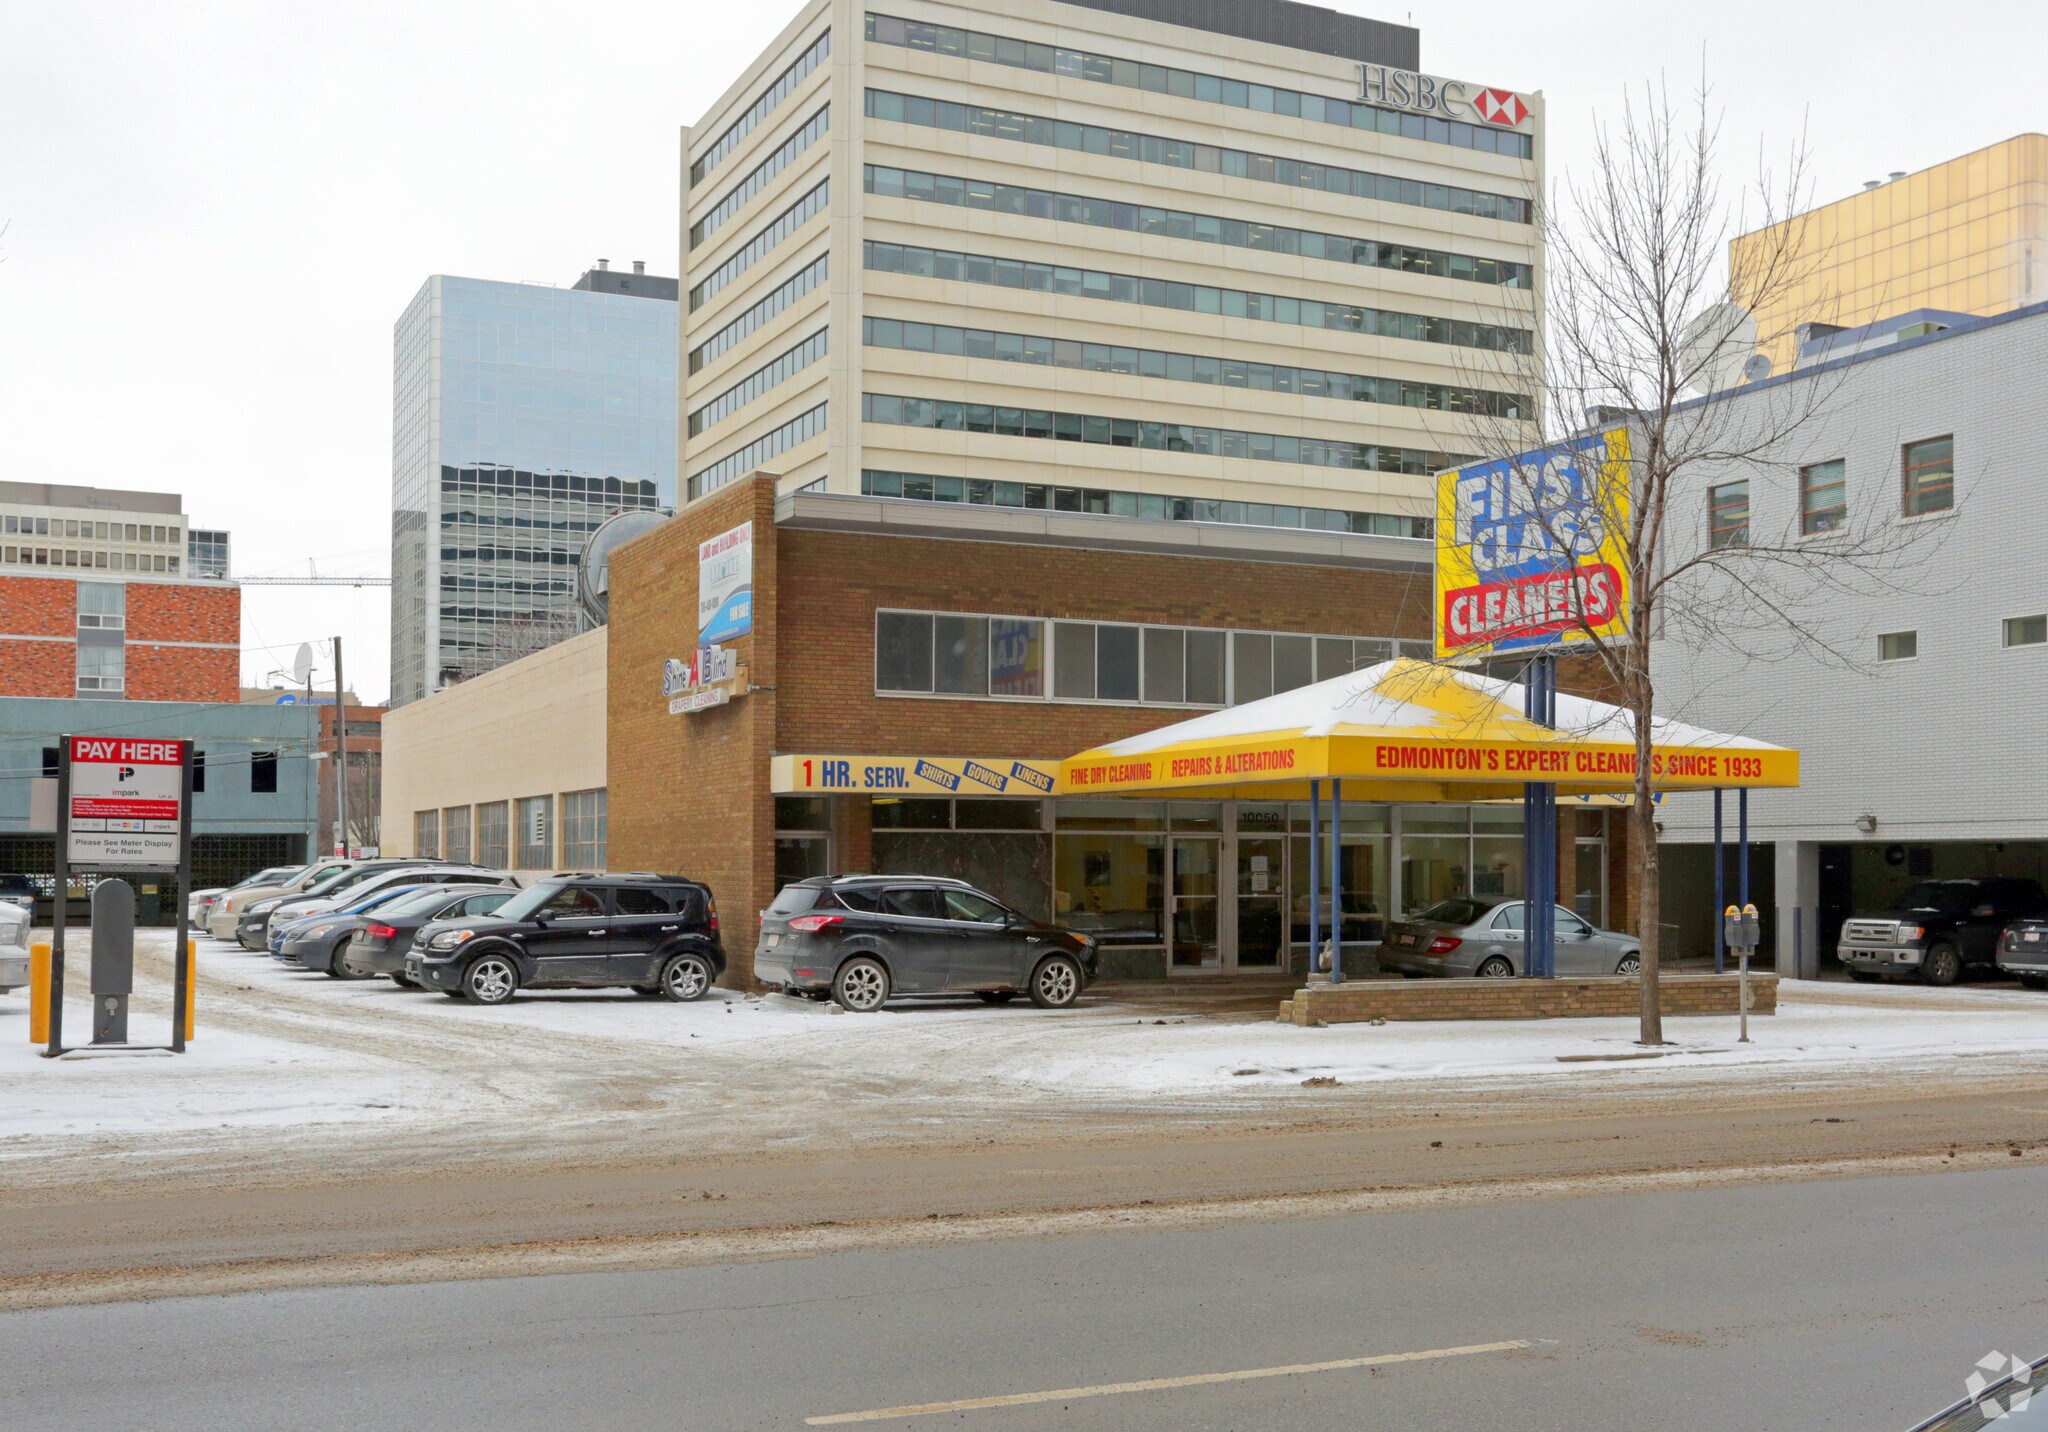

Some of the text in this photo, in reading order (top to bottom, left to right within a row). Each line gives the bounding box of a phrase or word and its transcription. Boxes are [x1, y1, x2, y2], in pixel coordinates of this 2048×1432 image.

[1357, 64, 1467, 118] HSBC
[1457, 445, 1605, 546] FIRST
[1472, 507, 1604, 571] CLASS
[1451, 572, 1608, 635] CLEANERS
[663, 645, 728, 697] Shine A Blind
[671, 690, 719, 713] DRAPERY CLEANING
[77, 741, 178, 762] PAY HERE
[1171, 749, 1295, 778] REPAIRS & ALTERATIONS
[1376, 746, 1762, 778] EDMONTON'S EXPERT CLEANS SINCE 1933
[803, 759, 910, 788] 1 HR. SERV.
[920, 763, 955, 788] SHIRTS
[967, 764, 1002, 789] GOWNS
[1015, 766, 1050, 790] LINENS
[1071, 762, 1152, 785] FINE DRY CLEANING
[112, 789, 140, 797] impark
[1242, 812, 1279, 823] 10050
[75, 838, 102, 847] Please
[104, 839, 119, 847] See
[145, 840, 173, 849] Display
